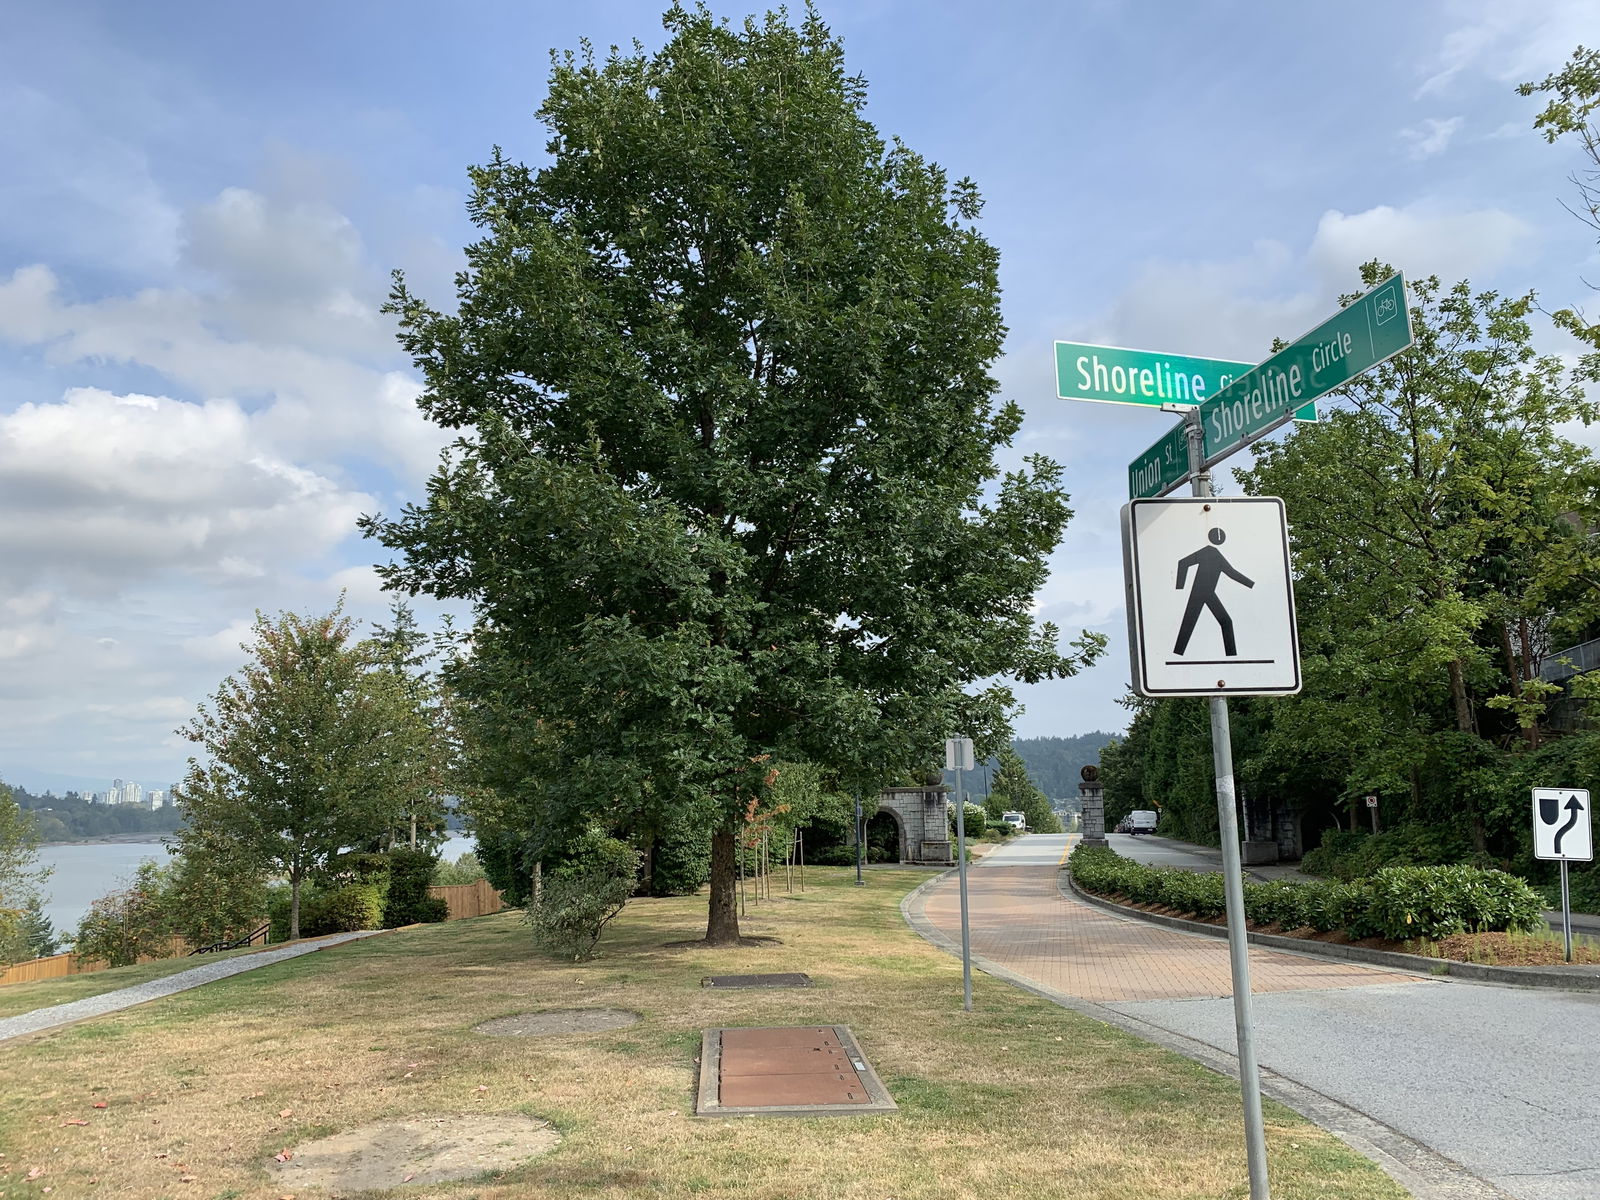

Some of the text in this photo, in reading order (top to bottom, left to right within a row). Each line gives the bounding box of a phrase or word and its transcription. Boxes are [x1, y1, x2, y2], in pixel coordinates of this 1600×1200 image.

[1076, 355, 1206, 401] Shoreline
[1212, 331, 1352, 443] Shoreline Circle
[1131, 442, 1173, 498] Union St
